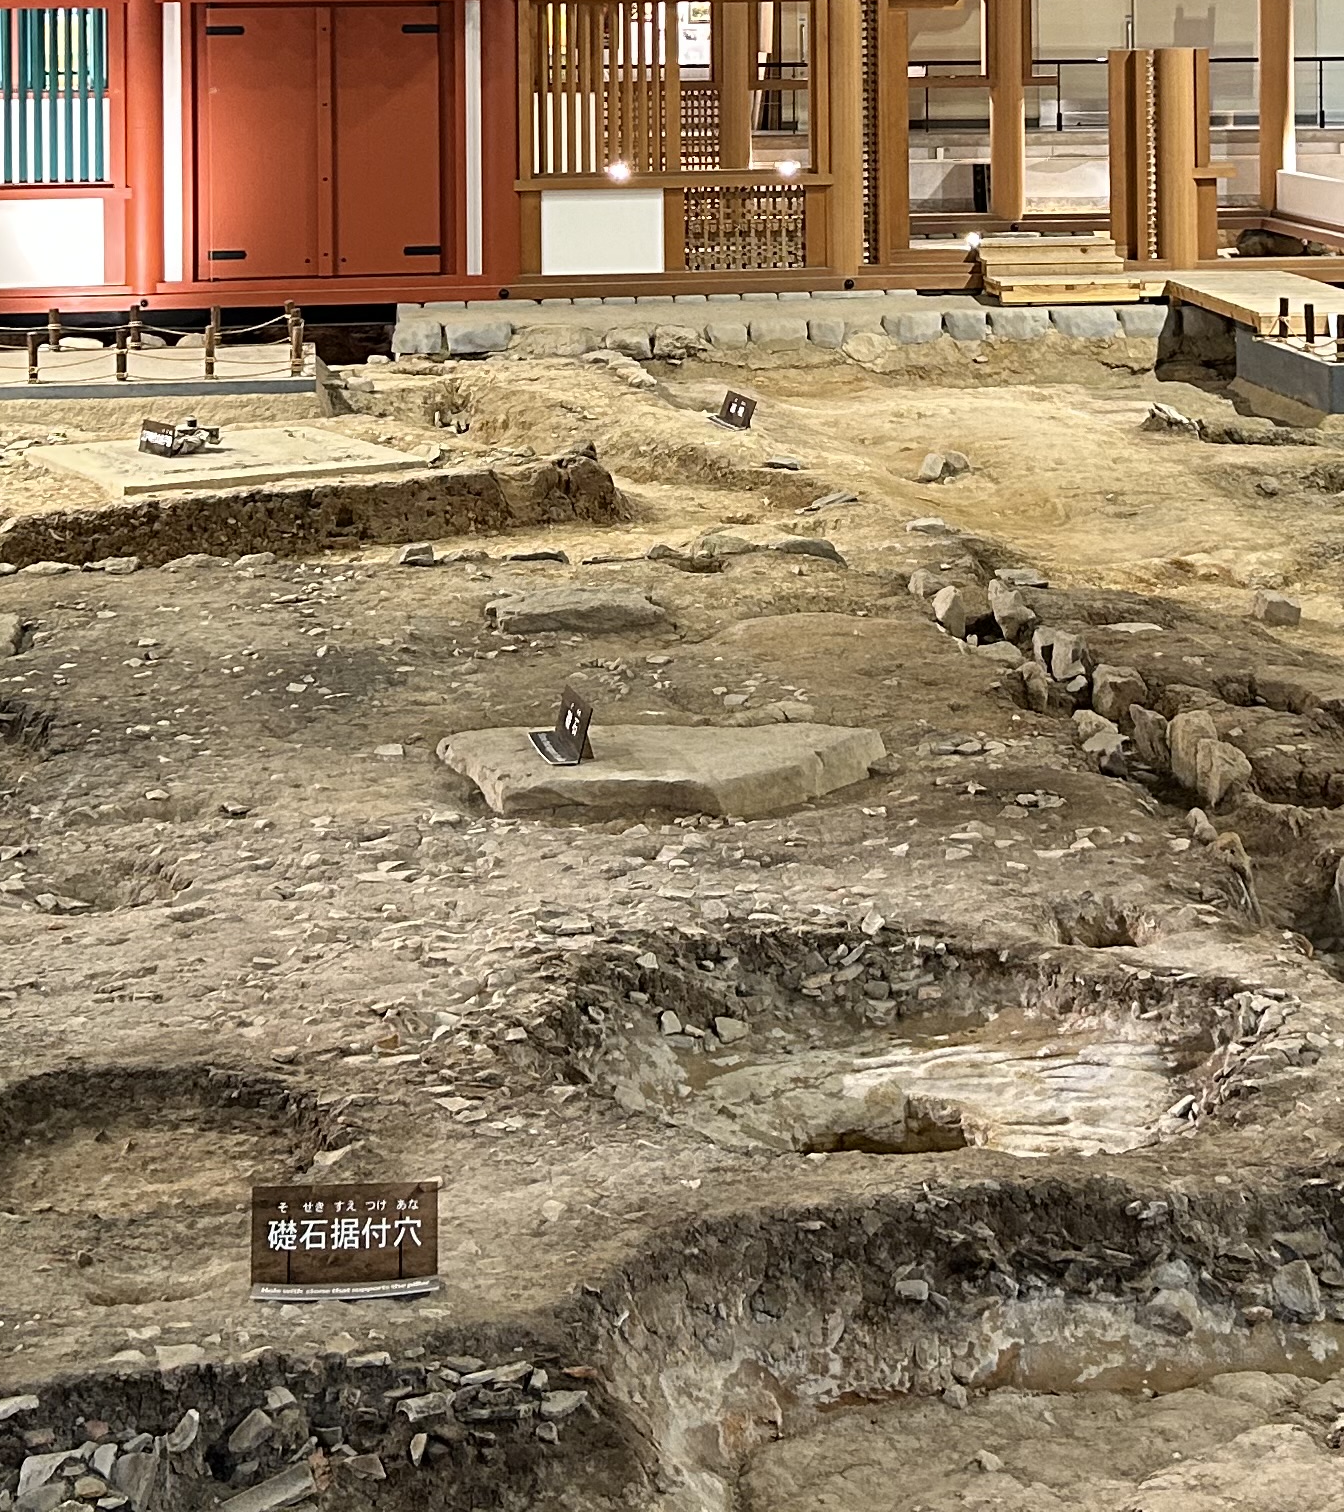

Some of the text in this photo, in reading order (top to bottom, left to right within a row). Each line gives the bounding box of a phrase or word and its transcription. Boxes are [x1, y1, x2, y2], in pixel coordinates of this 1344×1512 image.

[277, 1198, 419, 1214] そ せき すえ つけ あな
[267, 1216, 422, 1251] 礎石据付穴
